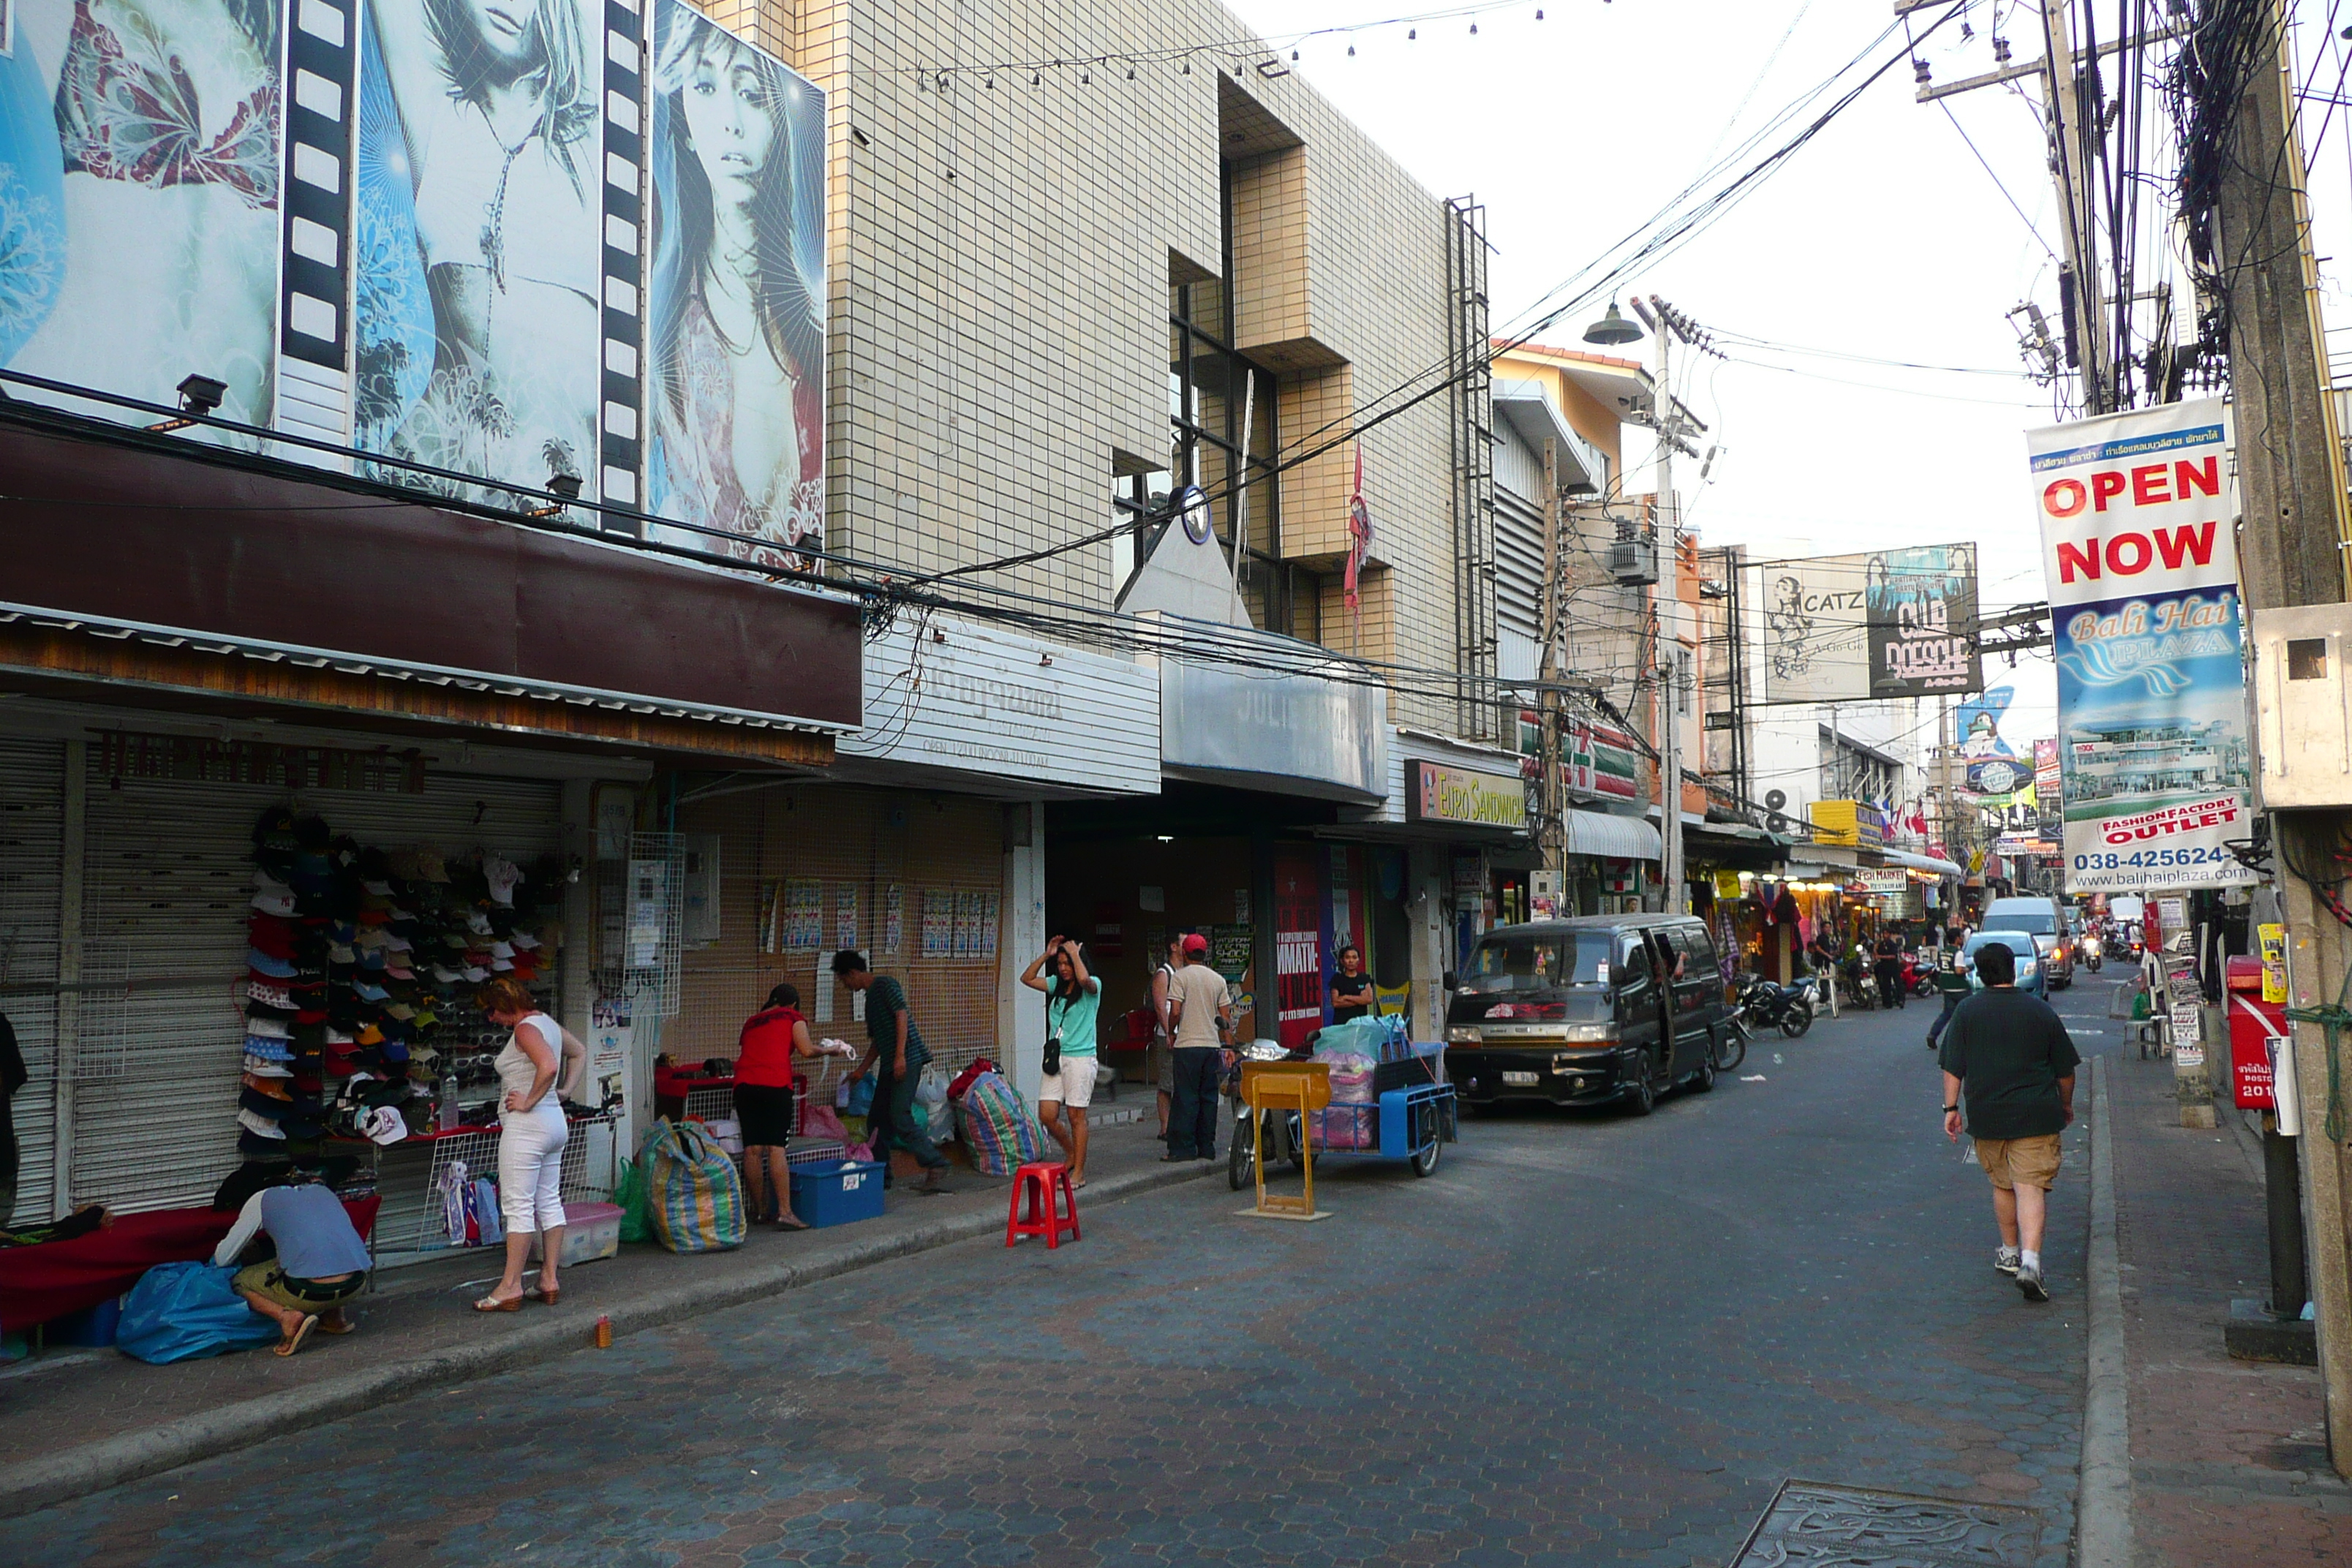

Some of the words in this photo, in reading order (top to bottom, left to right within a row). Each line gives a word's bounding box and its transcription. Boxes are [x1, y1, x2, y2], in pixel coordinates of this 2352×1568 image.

[2043, 455, 2220, 519] OPEN
[2056, 521, 2217, 584] NOW
[1804, 592, 1865, 612] CATZ
[2070, 603, 2146, 641] Bali
[2155, 594, 2231, 633] Hai
[1899, 600, 1949, 639] CLUB
[2114, 631, 2233, 664] PLAZA
[1573, 724, 1591, 788] 7
[1438, 773, 1469, 820] EURO
[1470, 778, 1525, 826] SANDWICH
[2102, 811, 2166, 832] FASHION
[2168, 797, 2235, 819] FACTORY
[2105, 808, 2238, 845] OUTLET
[1858, 869, 1874, 881] FISH
[1876, 869, 1904, 881] MARKET
[2074, 847, 2232, 870] 038-425624-
[1870, 882, 1905, 890] RESTAURANT
[2075, 867, 2249, 887] www.balihaiplaza.com
[1276, 941, 1319, 975] ИМАТИ:
[2242, 1085, 2271, 1097] 201
[2244, 1074, 2272, 1082] POSTC
